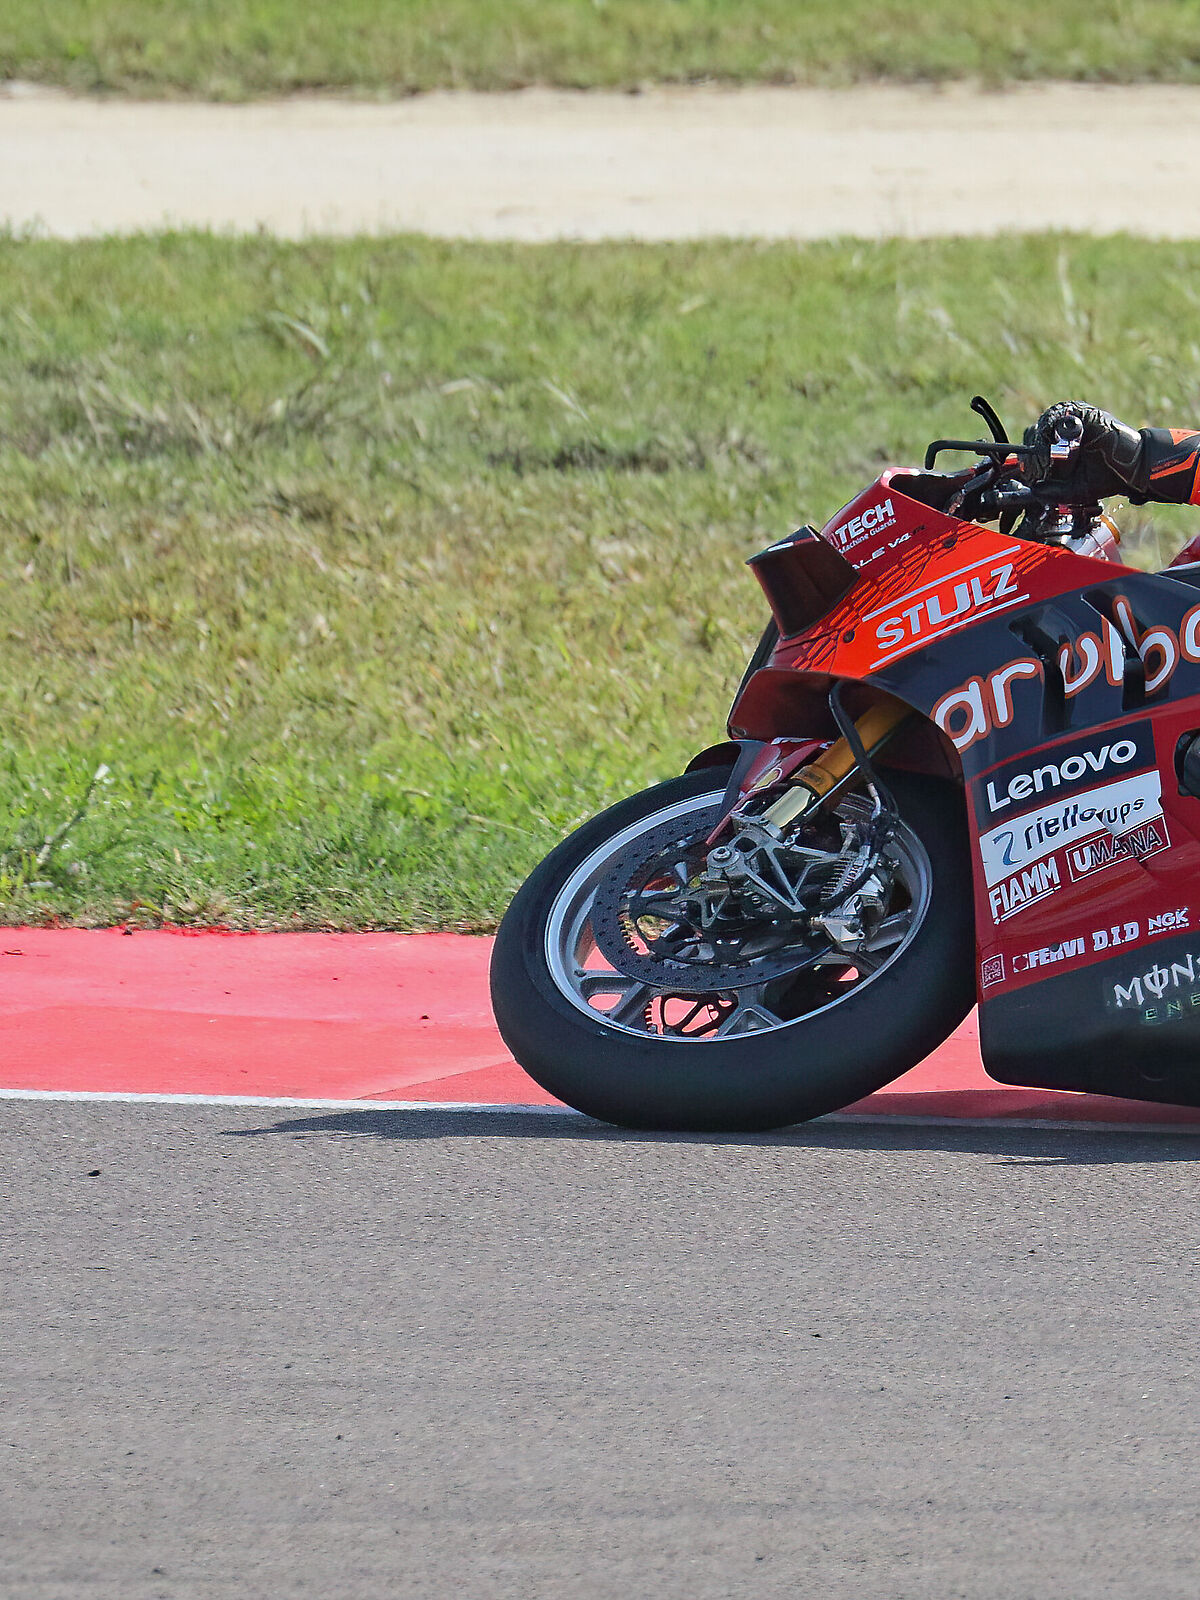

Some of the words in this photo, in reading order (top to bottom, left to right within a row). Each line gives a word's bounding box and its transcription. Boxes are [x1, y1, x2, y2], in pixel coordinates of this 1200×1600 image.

[876, 563, 1018, 650] STULZ
[986, 740, 1137, 812] Lenovo
[1073, 824, 1164, 874] UMANA
[988, 857, 1061, 919] FIAMM
[1092, 921, 1140, 951] D.I.D
[1148, 907, 1189, 930] NGK
